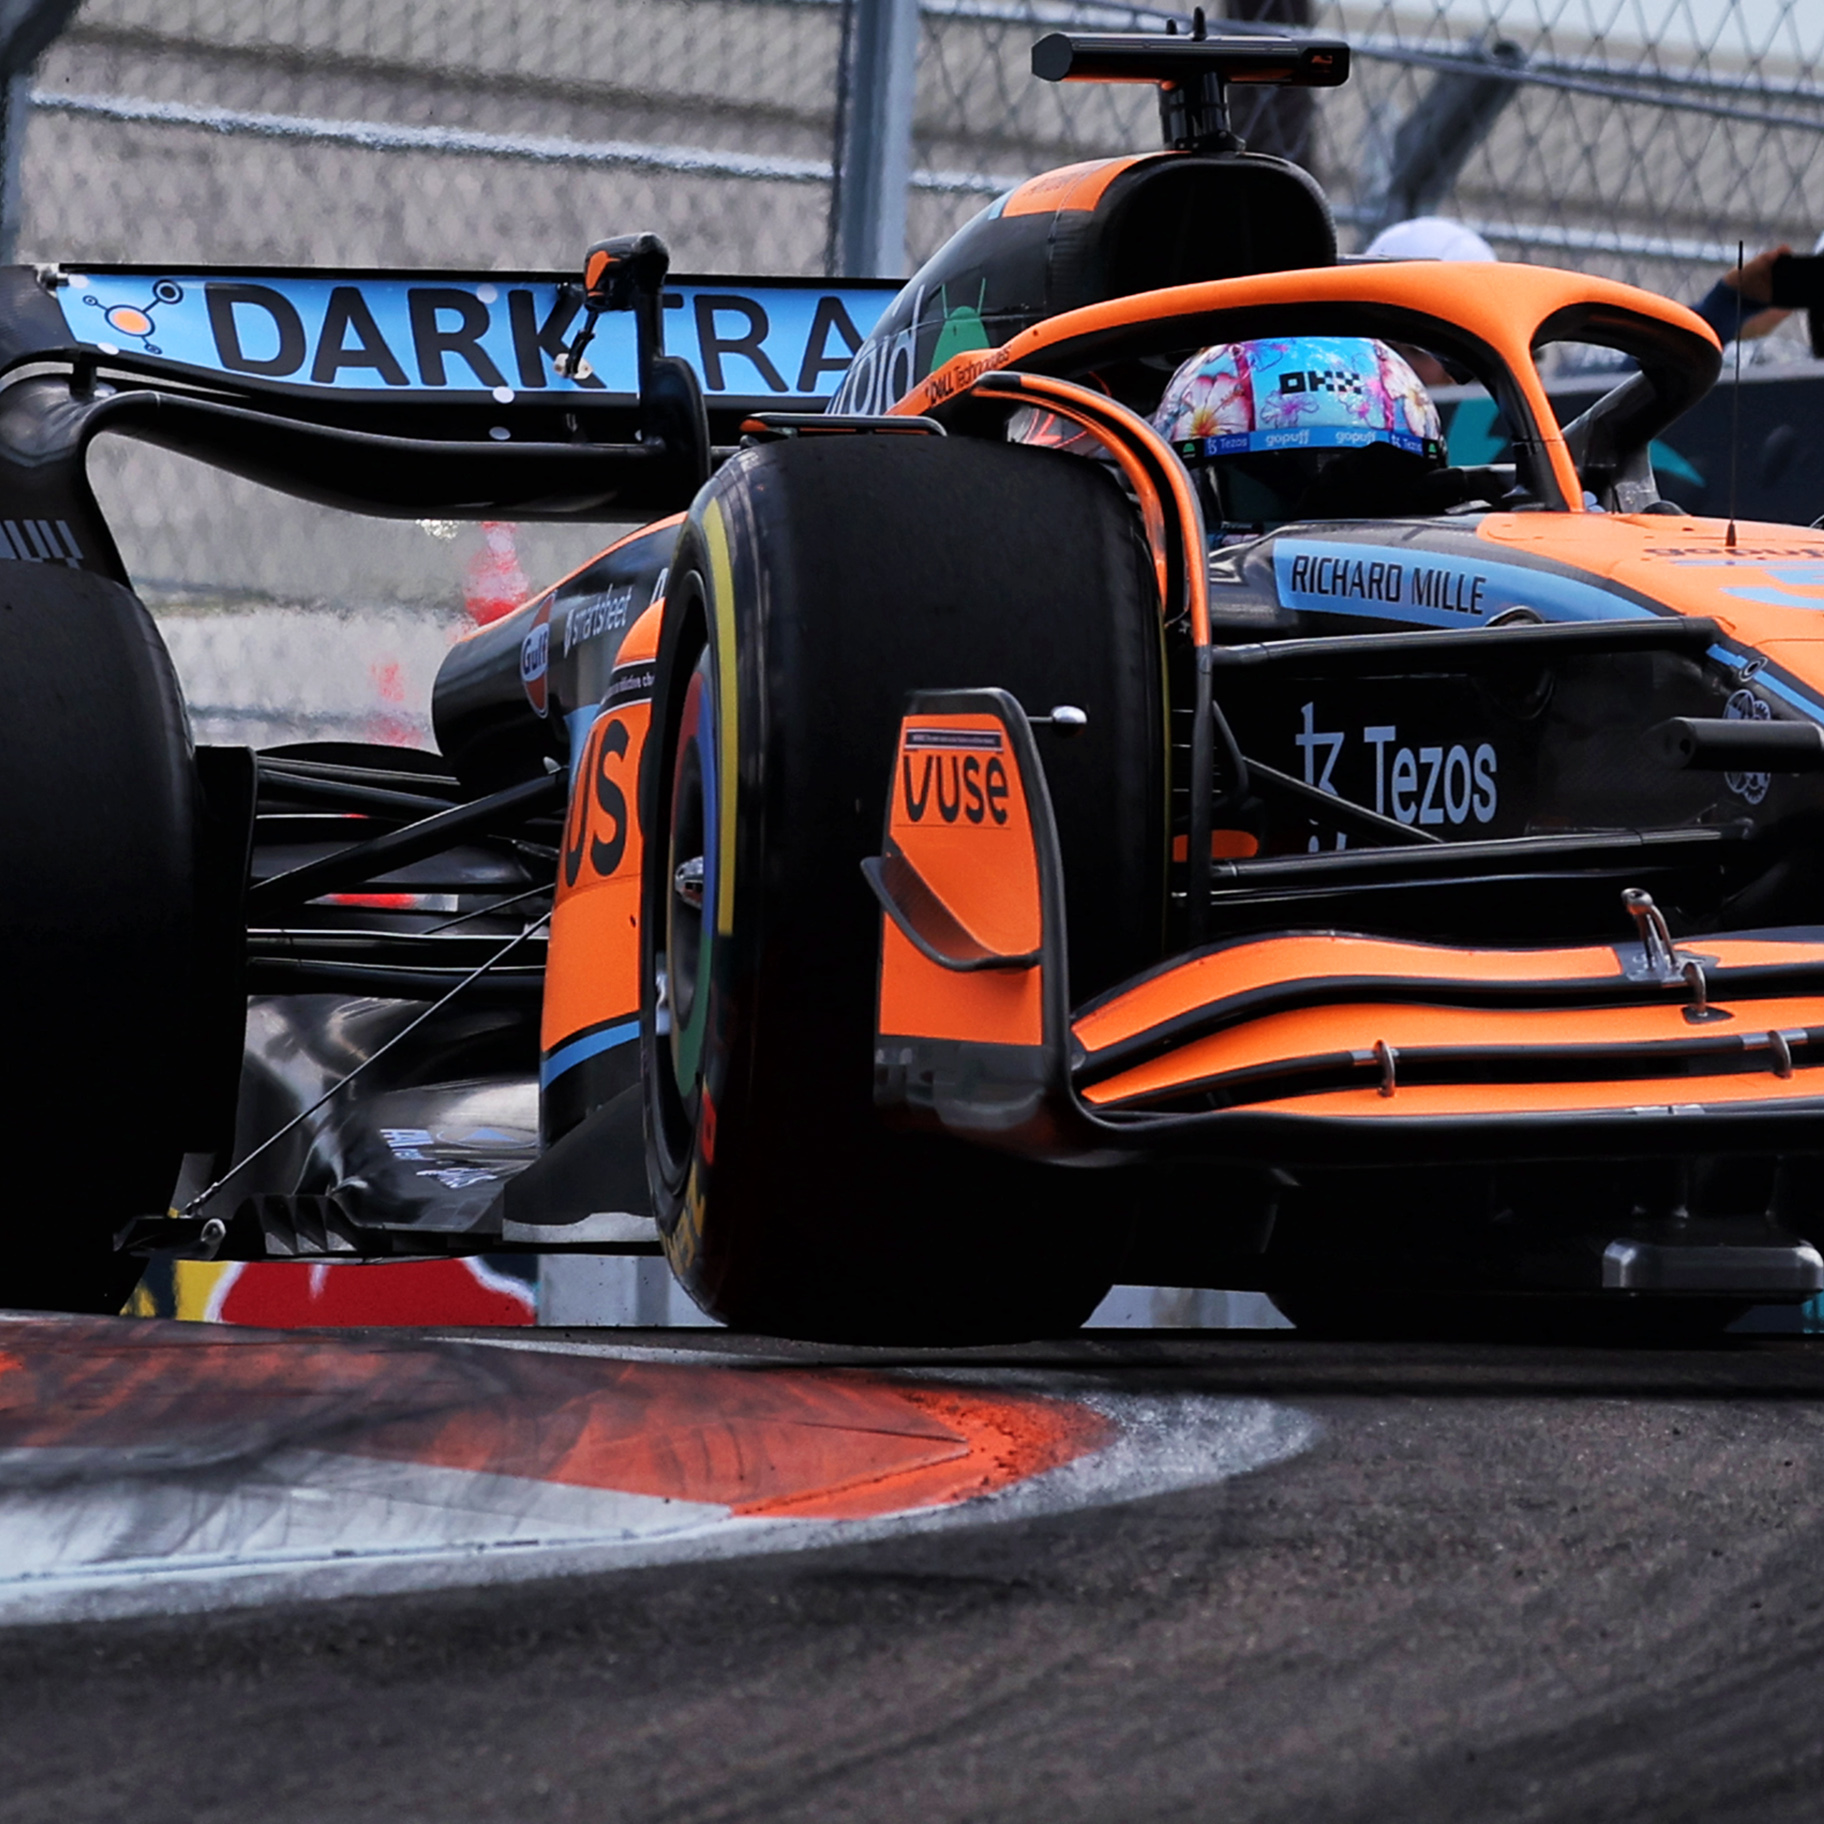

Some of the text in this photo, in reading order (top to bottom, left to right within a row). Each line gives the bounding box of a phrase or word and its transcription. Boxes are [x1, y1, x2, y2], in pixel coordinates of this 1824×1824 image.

[1266, 429, 1310, 447] gopuff
[1291, 555, 1487, 615] RICHARD MILLE
[525, 629, 549, 675] Gulf
[1364, 725, 1497, 825] Tezos
